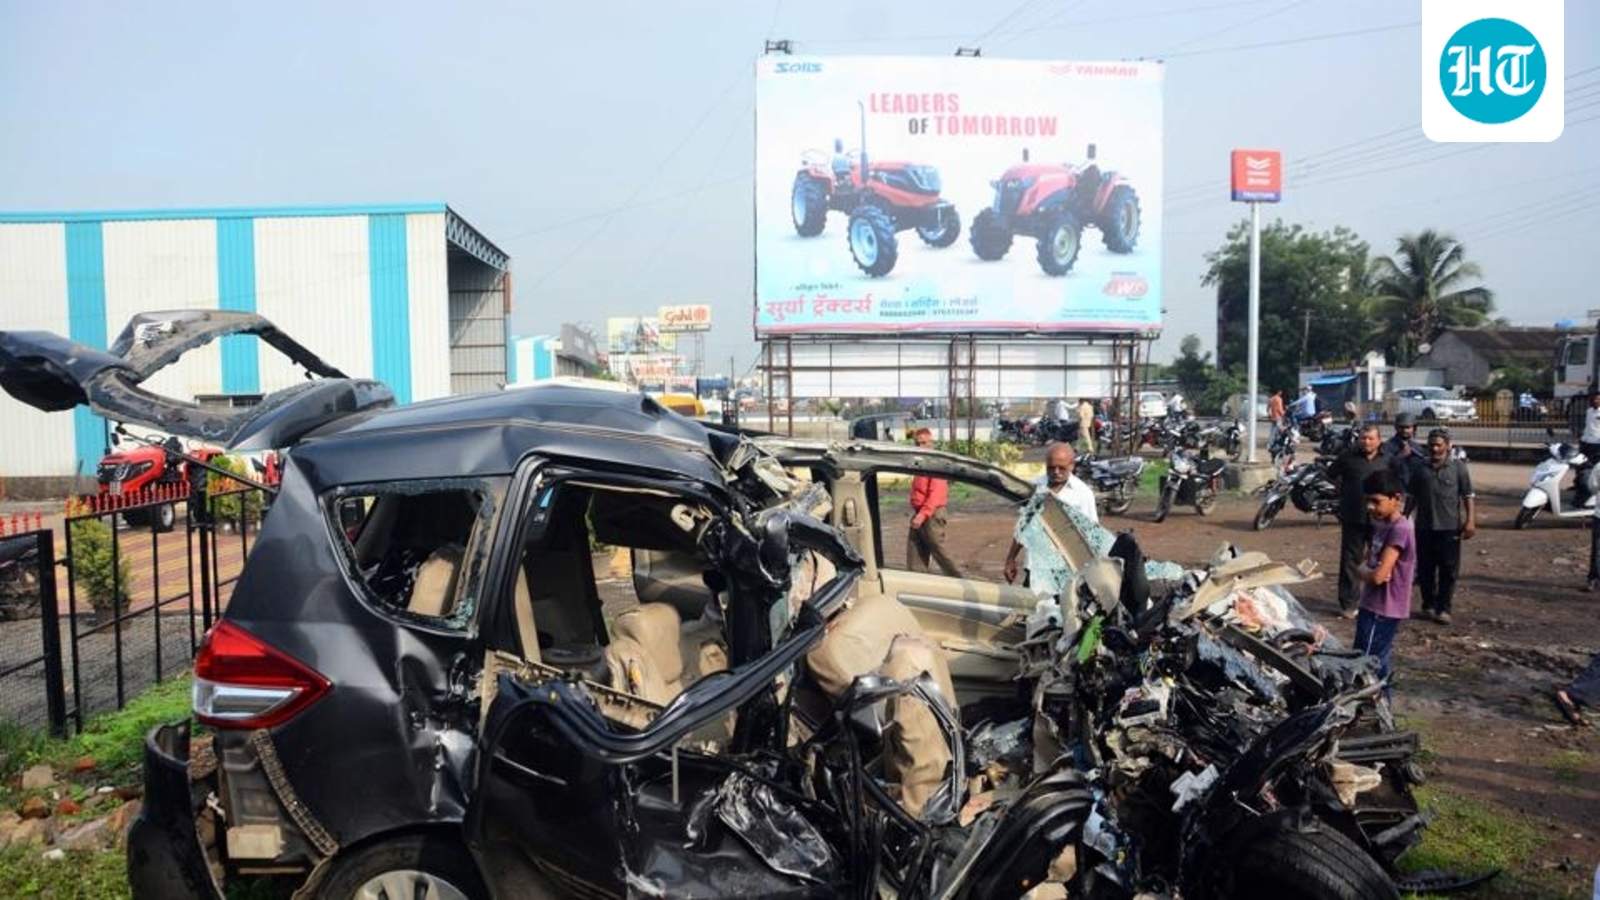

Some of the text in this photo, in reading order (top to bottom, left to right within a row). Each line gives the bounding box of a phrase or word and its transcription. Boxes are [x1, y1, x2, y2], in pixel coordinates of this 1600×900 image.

[870, 93, 960, 113] LEADERS
[908, 116, 1057, 136] OF TOMORROW
